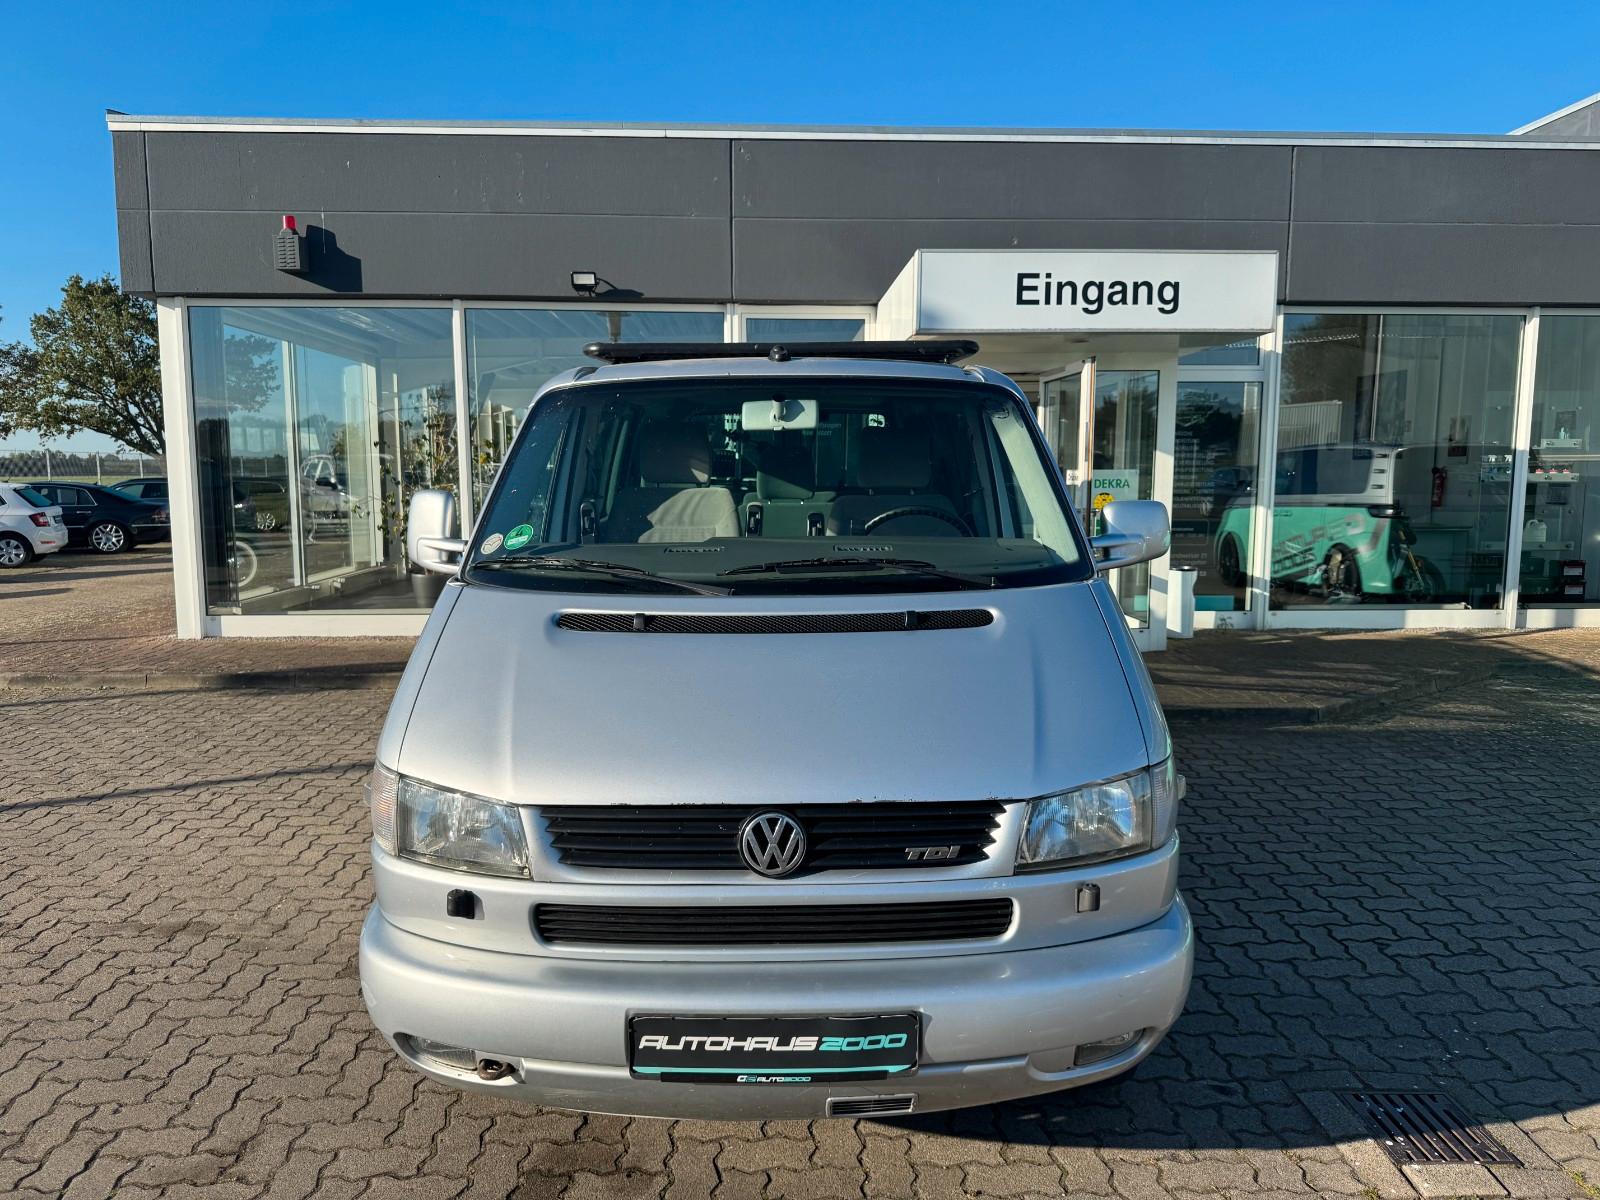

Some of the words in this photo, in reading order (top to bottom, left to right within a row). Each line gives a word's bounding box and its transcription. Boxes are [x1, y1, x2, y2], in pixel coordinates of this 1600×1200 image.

[1016, 273, 1180, 315] Eingang
[1094, 479, 1130, 489] DEKRA
[905, 845, 961, 861] TDI
